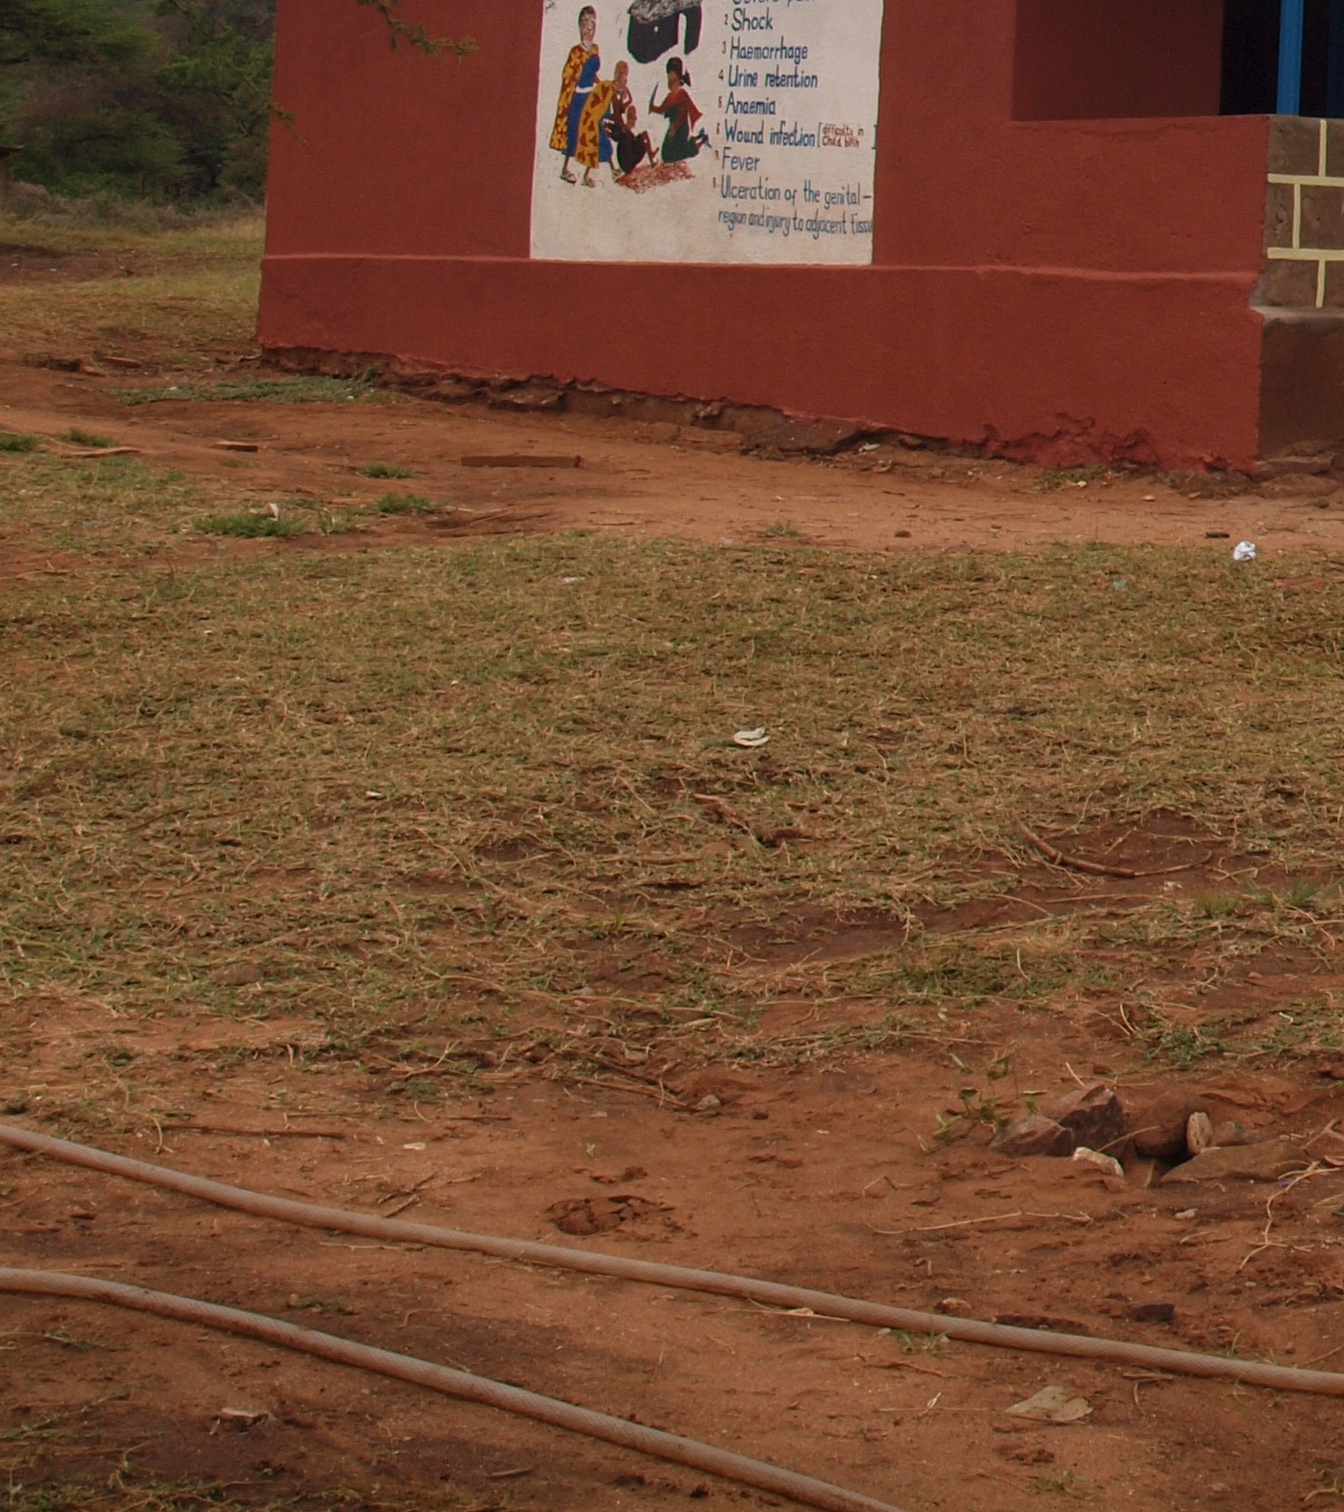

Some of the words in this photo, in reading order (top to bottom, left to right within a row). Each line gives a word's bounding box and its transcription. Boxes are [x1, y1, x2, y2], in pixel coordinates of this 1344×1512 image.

[724, 14, 729, 25] 2
[731, 7, 774, 31] Shock
[722, 41, 727, 54] 3
[730, 35, 808, 65] Haemorrhage
[718, 69, 724, 82] 4
[728, 64, 758, 88] Urine
[765, 64, 818, 88] retention
[725, 91, 776, 115] Anaemia
[724, 119, 764, 144] Wound
[722, 146, 760, 171] Fever
[720, 174, 780, 200] Ulceration
[784, 187, 797, 206] of
[803, 180, 820, 203] the
[718, 203, 747, 231] region
[748, 204, 764, 227] and
[792, 210, 803, 230] to
[805, 209, 847, 239] adjacent
